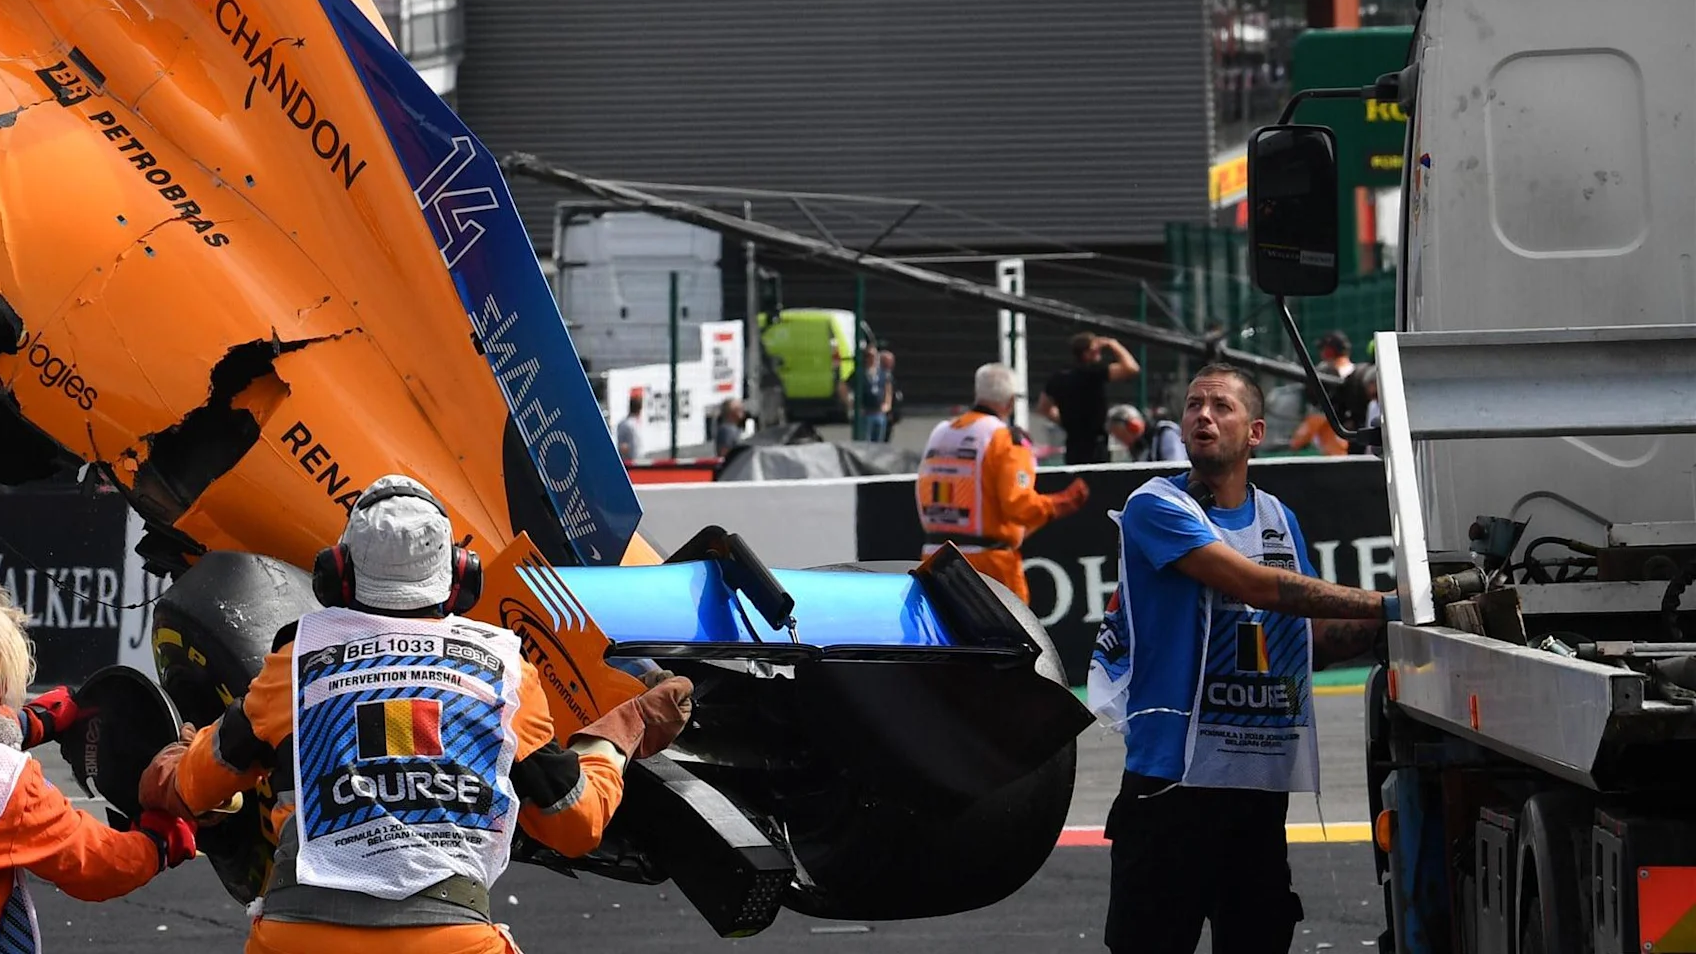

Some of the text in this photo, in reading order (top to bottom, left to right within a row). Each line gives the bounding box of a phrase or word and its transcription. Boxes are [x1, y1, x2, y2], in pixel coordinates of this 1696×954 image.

[88, 110, 230, 248] PETROBRAS
[414, 135, 500, 269] 14
[280, 420, 363, 519] RENA
[346, 639, 435, 660] BEL1033
[445, 643, 501, 672] 2018
[328, 669, 462, 691] INTERVENTION MARSHAL
[543, 663, 596, 726] Communic
[332, 771, 480, 805] COURSE
[334, 827, 381, 847] FORMULA
[389, 823, 403, 833] 20
